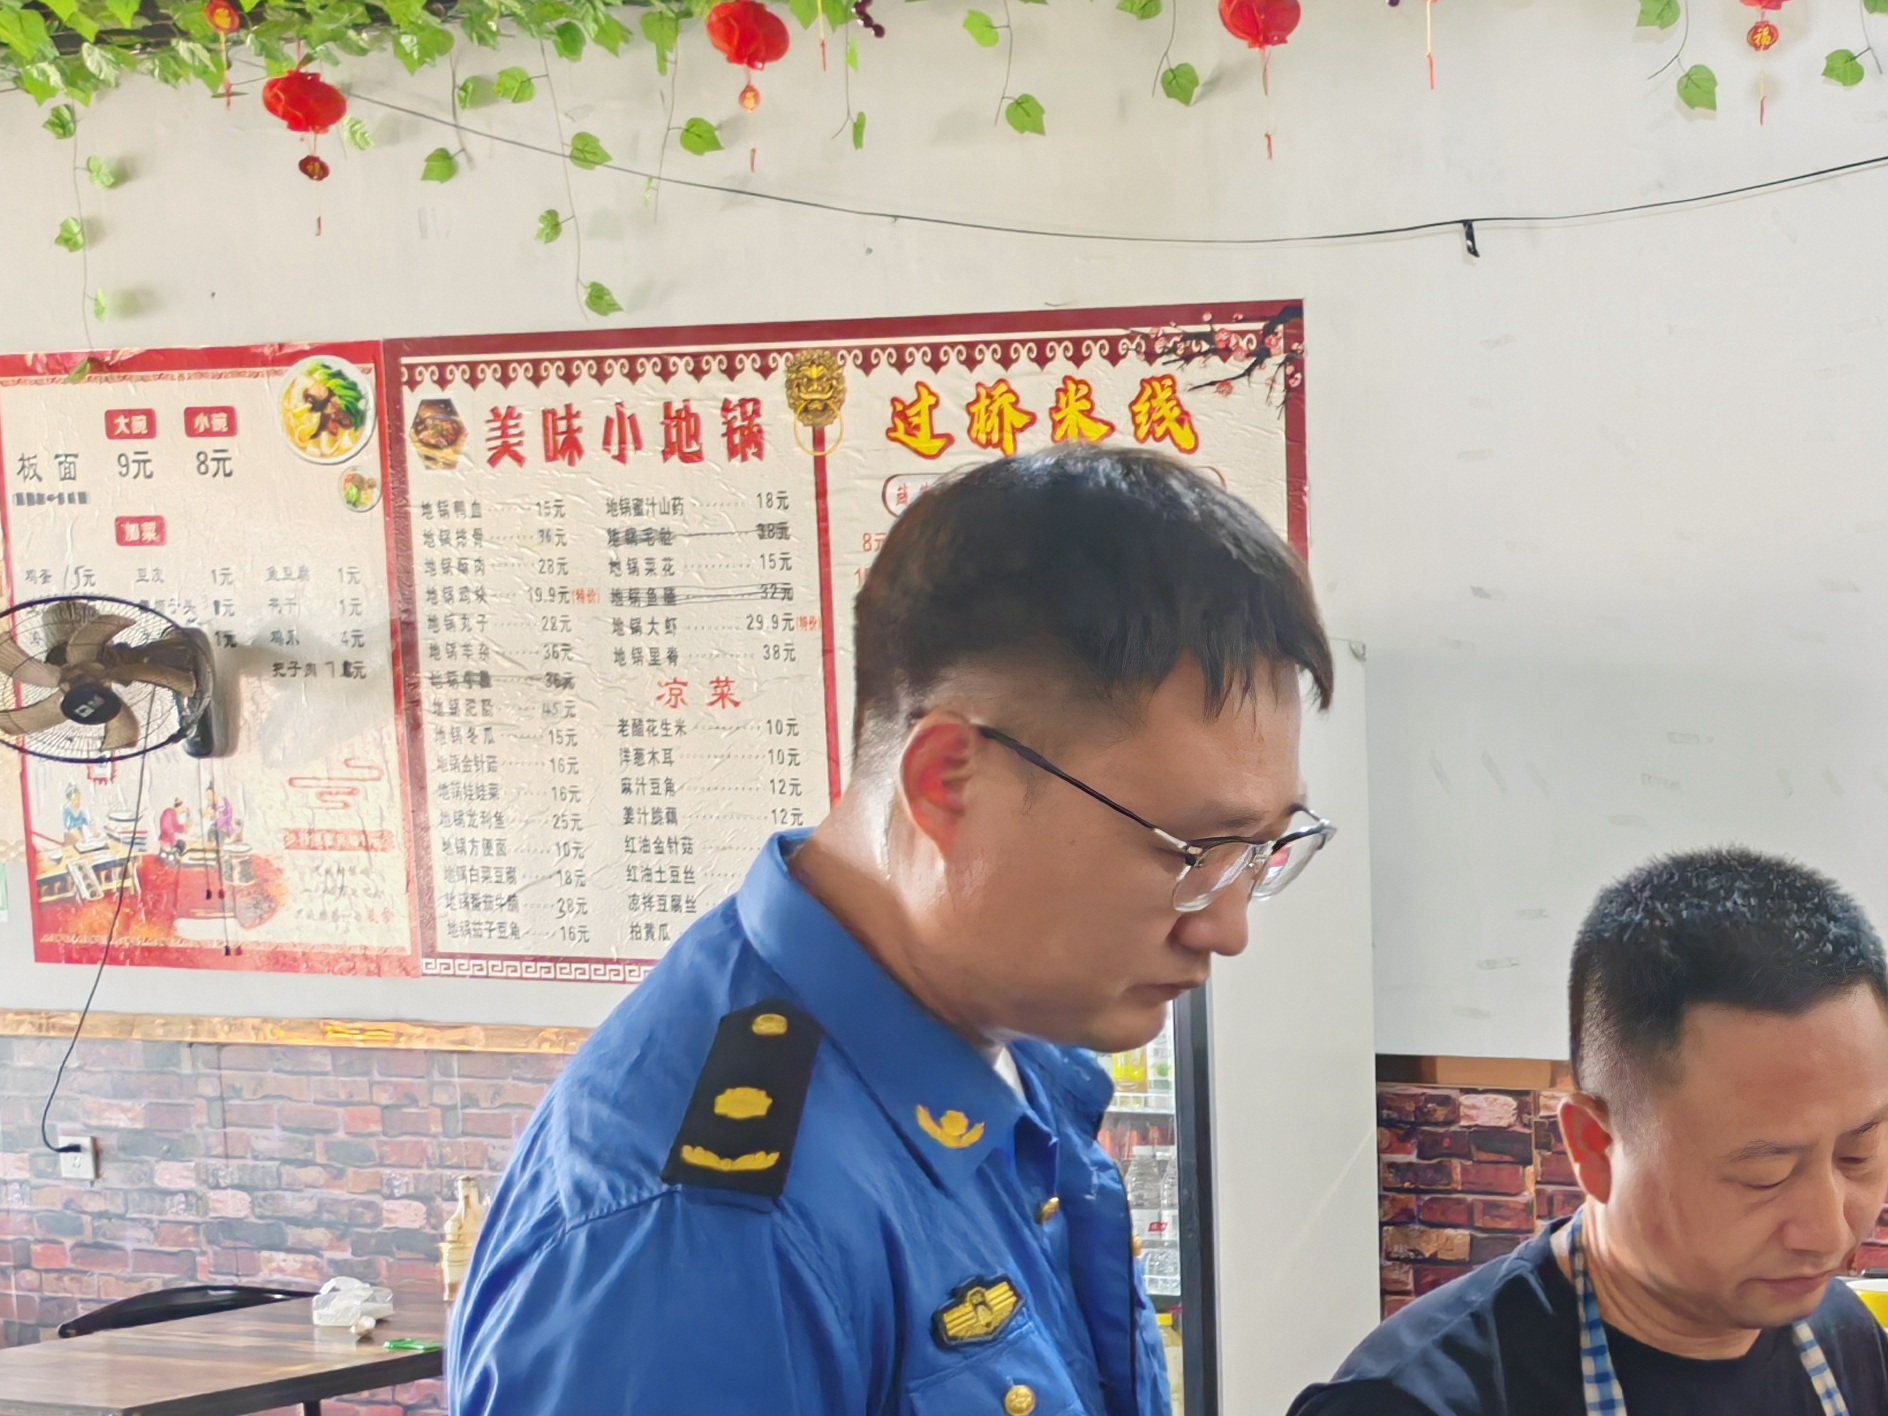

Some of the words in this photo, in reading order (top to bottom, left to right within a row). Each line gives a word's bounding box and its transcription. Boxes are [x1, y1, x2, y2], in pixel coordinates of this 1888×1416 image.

[886, 373, 1199, 459] 过桥米线
[485, 397, 767, 470] 美味小地锅
[17, 452, 79, 483] 板面
[117, 450, 154, 479] 9元
[196, 449, 233, 478] 8元
[757, 490, 790, 510] 18元
[760, 552, 792, 571] 15元
[763, 643, 796, 662] 38元
[656, 676, 742, 709] 凉菜
[617, 718, 687, 737] 老醋花生米
[766, 718, 799, 737] 10元
[548, 728, 578, 747] 15元
[550, 757, 579, 775] 16元
[768, 748, 801, 767] 10元
[552, 785, 581, 803] 16元
[769, 777, 802, 797] 12元
[552, 813, 583, 831] 25元
[771, 808, 804, 827] 12元
[555, 842, 585, 859] 10元
[556, 869, 586, 887] 18元
[560, 925, 590, 943] 16元
